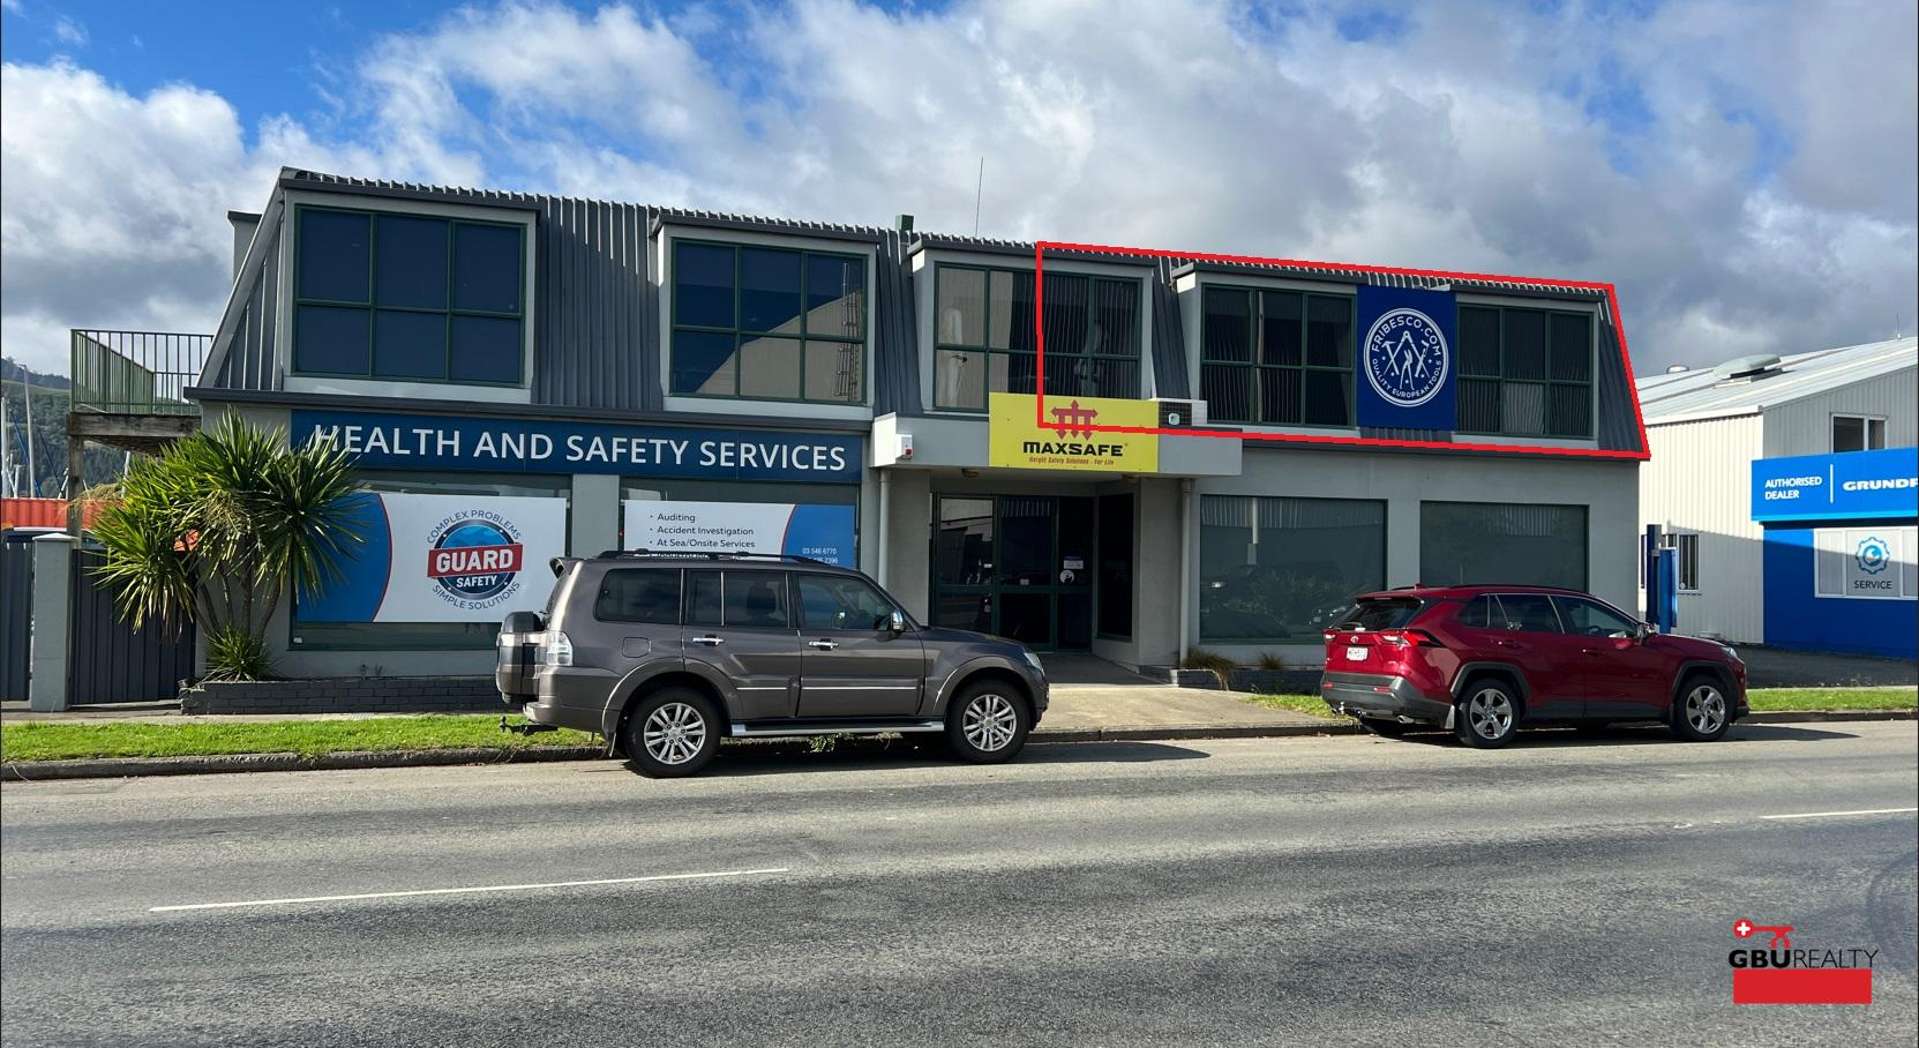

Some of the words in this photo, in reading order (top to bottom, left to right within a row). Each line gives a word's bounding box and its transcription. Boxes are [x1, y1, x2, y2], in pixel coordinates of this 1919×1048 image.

[1371, 315, 1441, 356] FRIBESCO.COM
[1372, 358, 1391, 390] QUALITY
[1392, 383, 1430, 398] EUROPEAN
[1428, 360, 1442, 386] TOOLS
[315, 424, 460, 457] HEALTH
[473, 431, 553, 460] AND
[566, 434, 688, 465] SAFETY
[699, 441, 845, 471] SERVICES
[1023, 441, 1123, 457] MAXSAFE
[1765, 476, 1823, 489] AUTHORISED
[1765, 490, 1800, 500] DEALER
[657, 513, 696, 523] Auditing
[427, 511, 469, 544] COMPLEX
[471, 509, 521, 540] PROBLEMS
[657, 526, 696, 534] Accident
[698, 527, 754, 536] Investigation
[657, 538, 668, 547] At
[670, 538, 718, 547] Sea/Onsite
[720, 540, 756, 548] Services
[436, 549, 513, 573] GUARD
[456, 575, 498, 588] SAFETY
[1854, 580, 1892, 590] SERVICE
[432, 584, 466, 609] SIMPLE
[468, 581, 520, 610] SOLUTIONS
